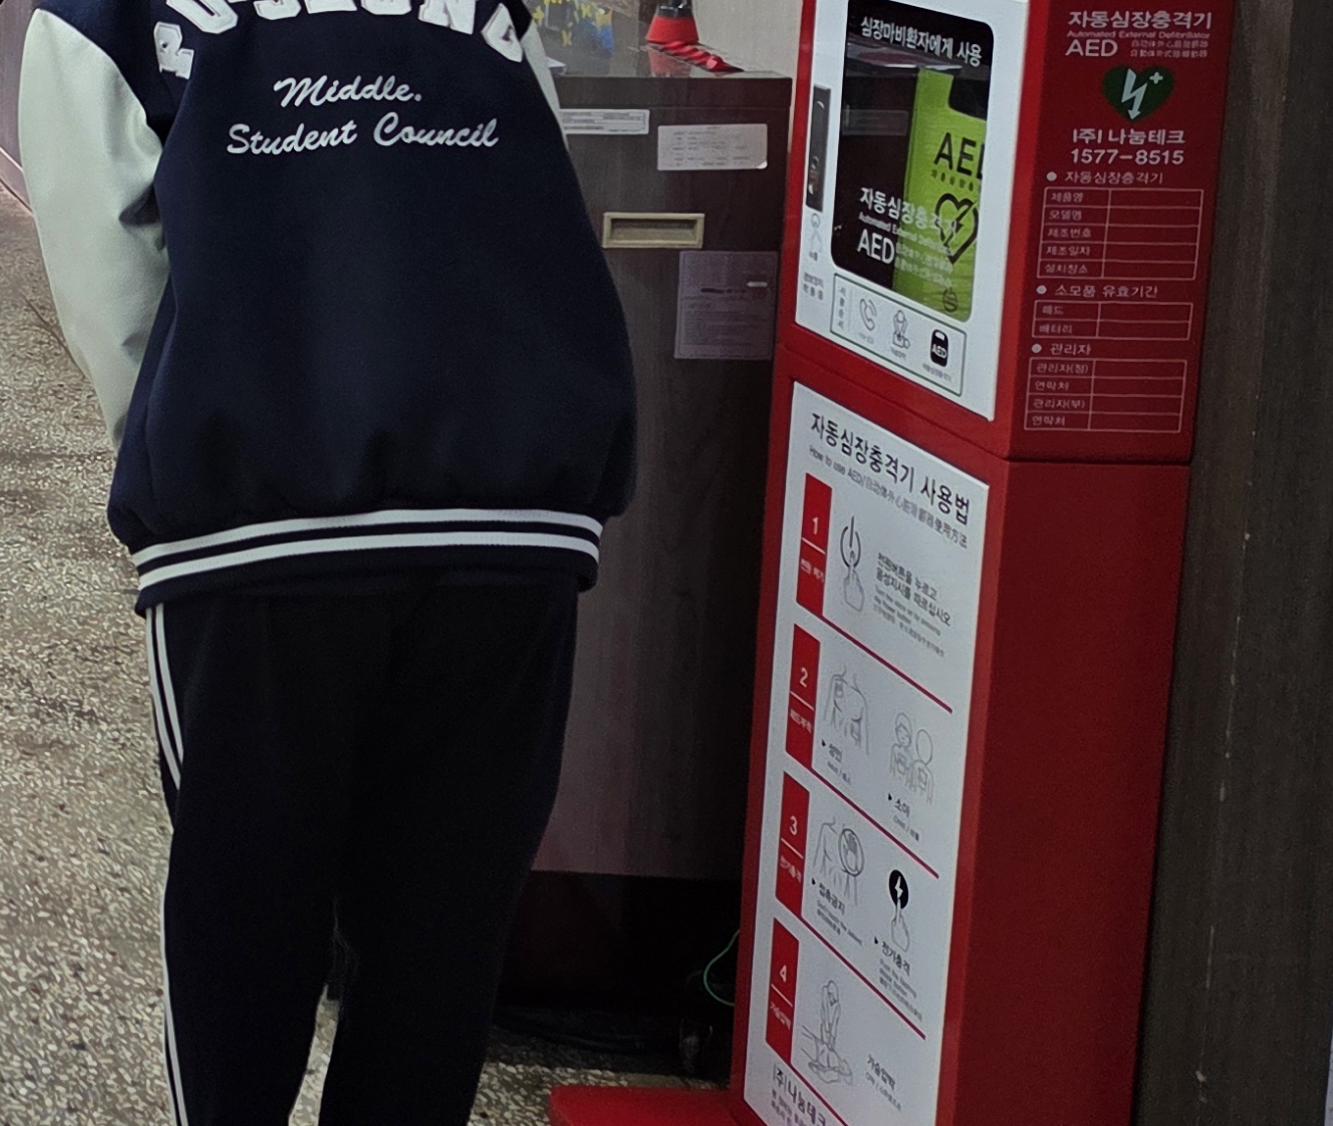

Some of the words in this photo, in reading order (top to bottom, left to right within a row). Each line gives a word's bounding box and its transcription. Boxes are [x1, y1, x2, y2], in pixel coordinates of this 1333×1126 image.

[1068, 10, 1212, 29] 자동심장충격기
[860, 16, 954, 59] 심장마비환자에게
[956, 41, 982, 67] 사용
[1065, 39, 1118, 57] AED
[273, 75, 422, 108] Middle.
[226, 119, 358, 155] Student
[373, 112, 499, 148] Council
[1108, 128, 1186, 146] 나눔테크
[1071, 148, 1184, 165] 1577-8515
[1065, 170, 1163, 185] 자동심장충격기
[857, 228, 895, 264] AED
[1055, 284, 1096, 298] 소모품
[1102, 285, 1158, 299] 유효기간
[932, 343, 948, 359] AED
[1049, 342, 1091, 356] 관리자
[1034, 380, 1069, 392] 연락처
[1032, 416, 1065, 426] 연락처
[811, 412, 915, 493] 자동심장충격기
[920, 476, 970, 526] 사용법
[812, 516, 819, 535] 1
[799, 666, 809, 688] 2
[789, 815, 798, 836] 3
[882, 940, 911, 976] 전기충격
[779, 964, 787, 983] 4
